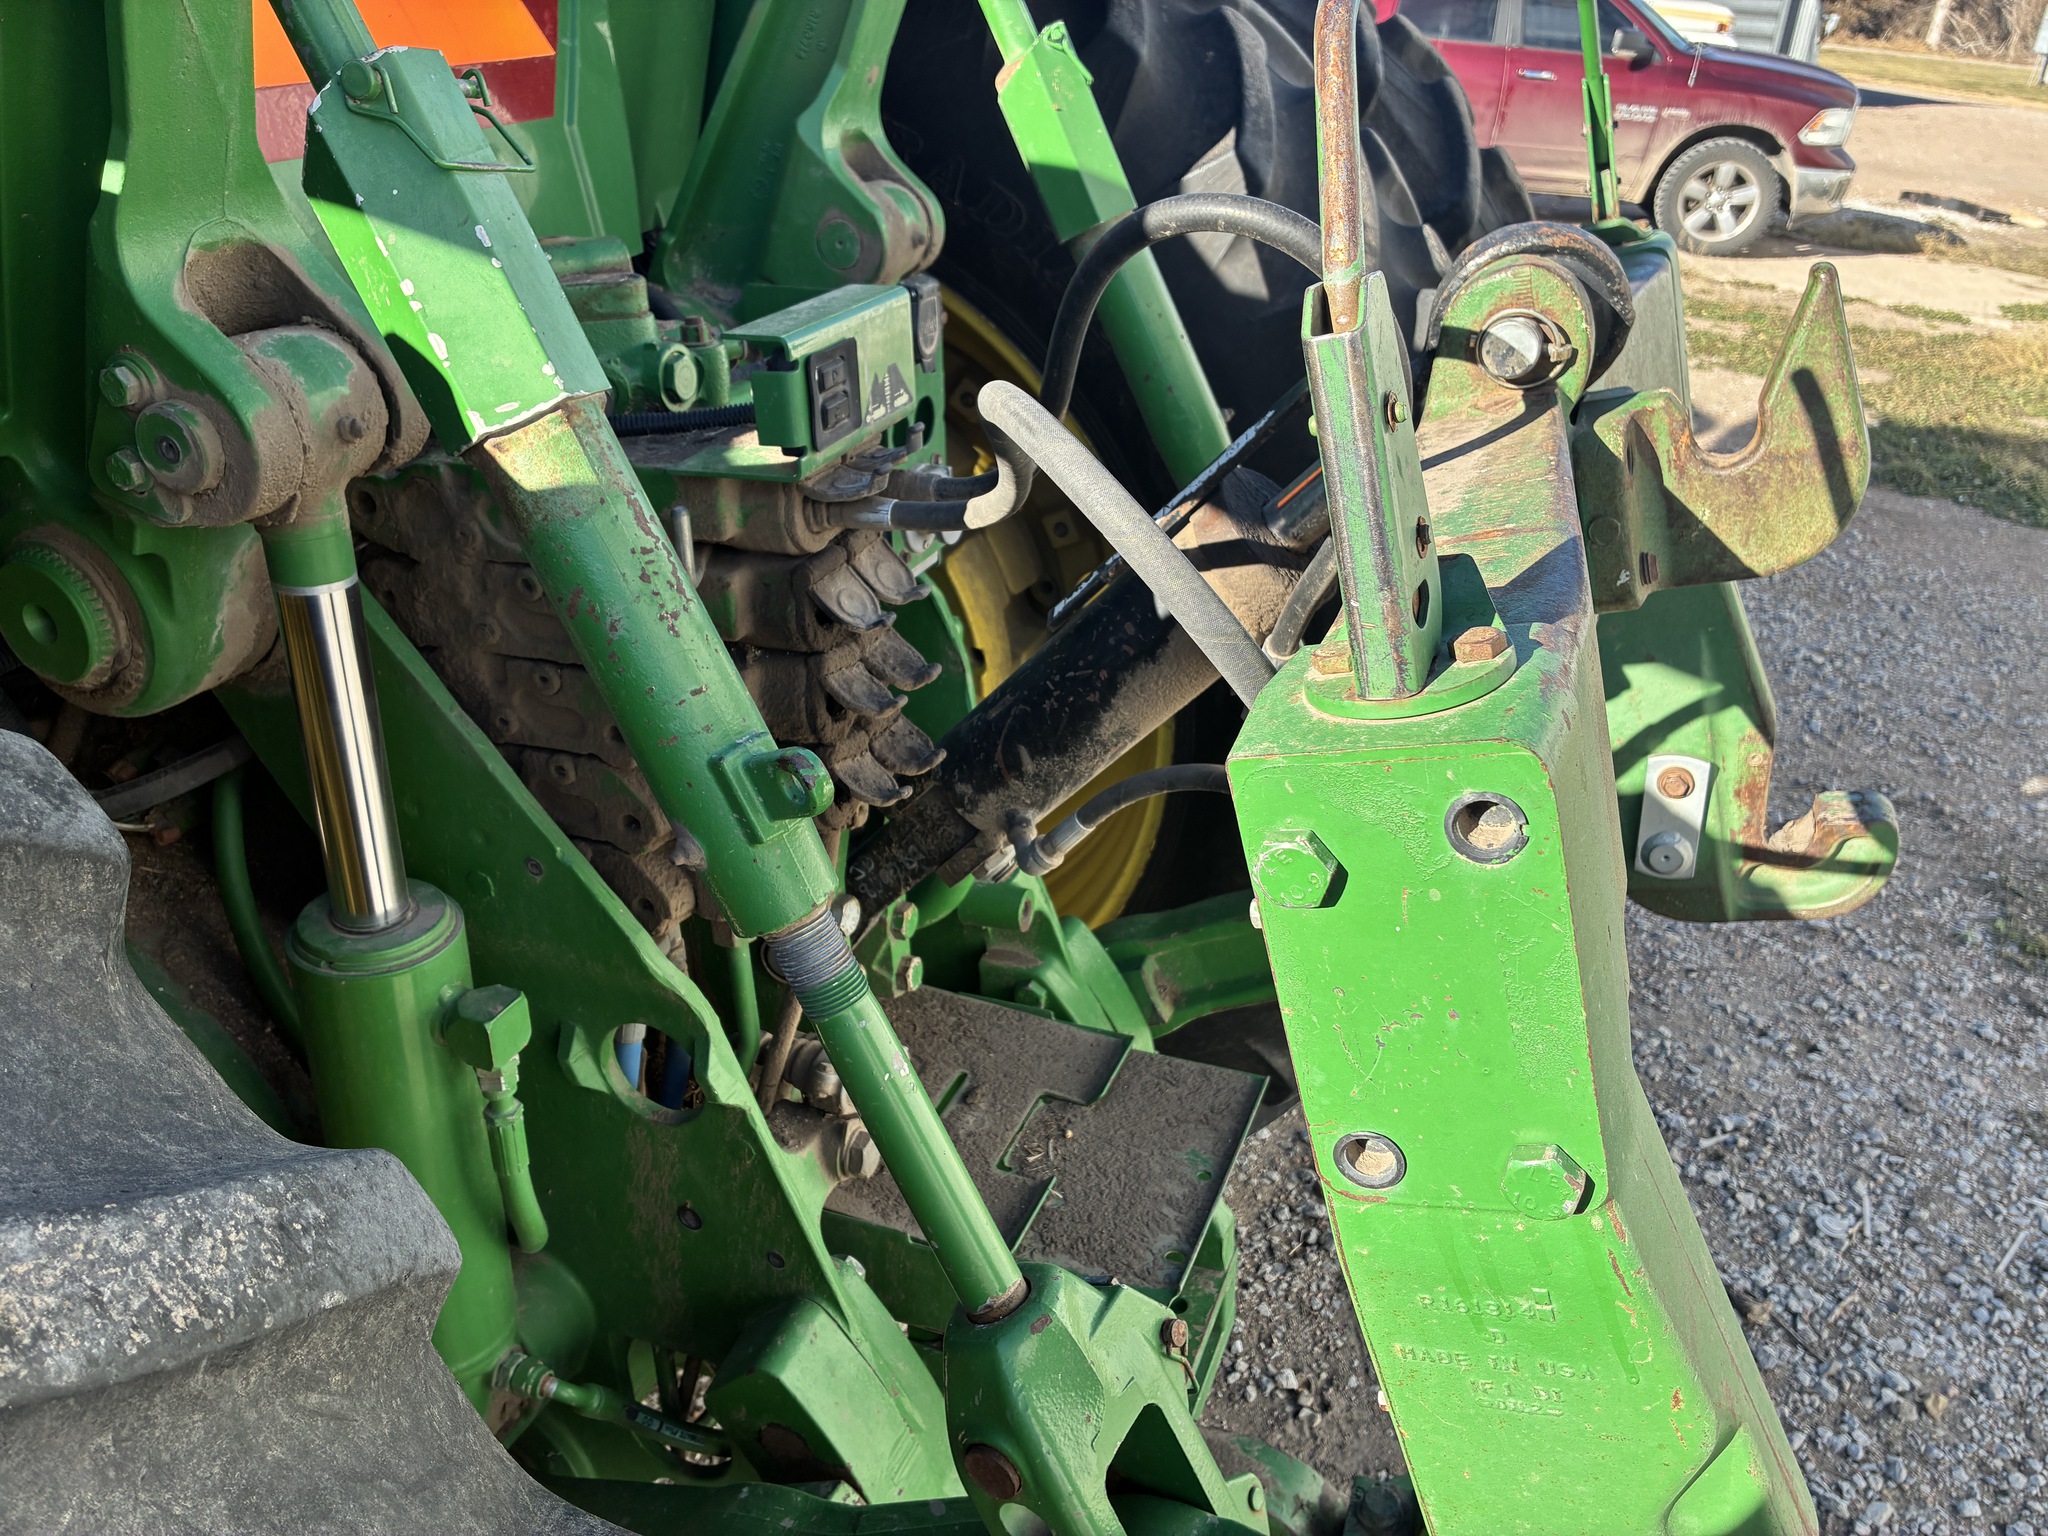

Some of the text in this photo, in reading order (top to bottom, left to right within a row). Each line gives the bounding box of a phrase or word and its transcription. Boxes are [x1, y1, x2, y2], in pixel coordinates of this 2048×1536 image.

[1394, 1344, 1596, 1381] MADE IN USA
